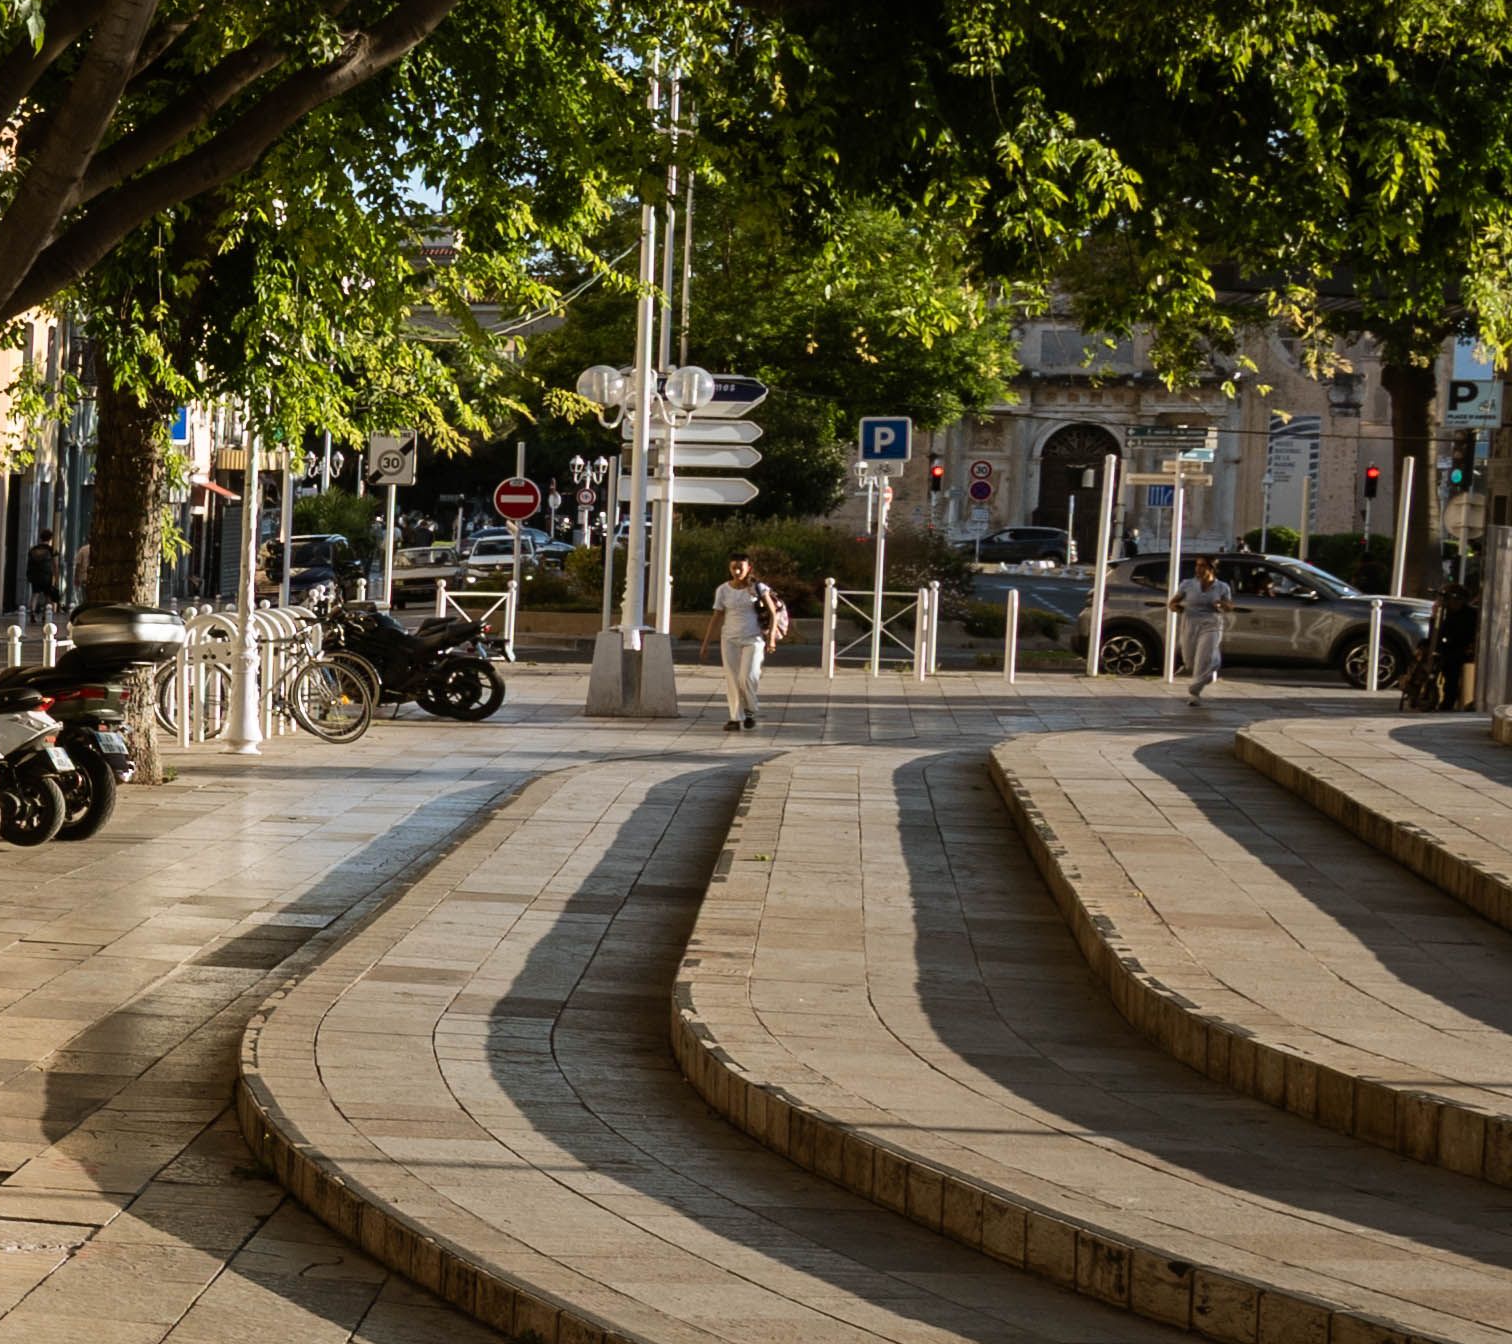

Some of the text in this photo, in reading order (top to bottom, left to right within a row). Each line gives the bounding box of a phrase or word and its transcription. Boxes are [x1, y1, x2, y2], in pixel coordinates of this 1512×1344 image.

[1448, 382, 1479, 411] P
[874, 427, 896, 454] P
[383, 457, 400, 469] 30
